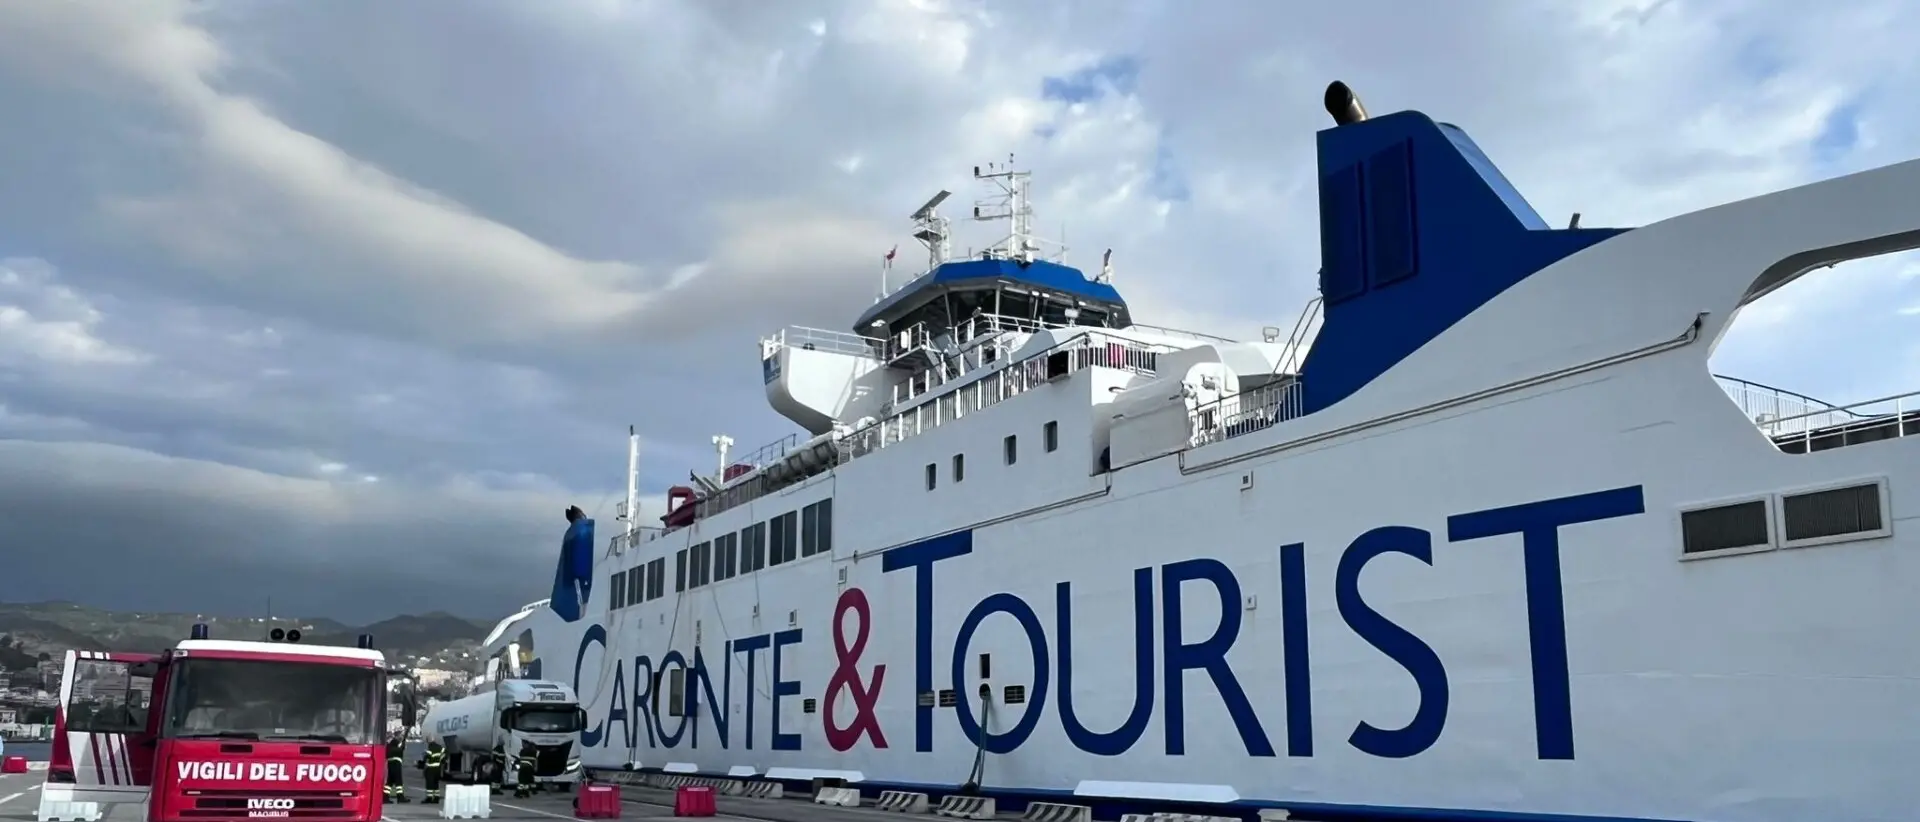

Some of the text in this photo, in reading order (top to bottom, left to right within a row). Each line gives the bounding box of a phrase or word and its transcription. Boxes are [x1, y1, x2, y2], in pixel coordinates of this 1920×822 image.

[574, 484, 1645, 761] CARONTE & TOURIST
[178, 761, 367, 783] VIGILI DEL FUOCO
[247, 798, 296, 810] IVECO
